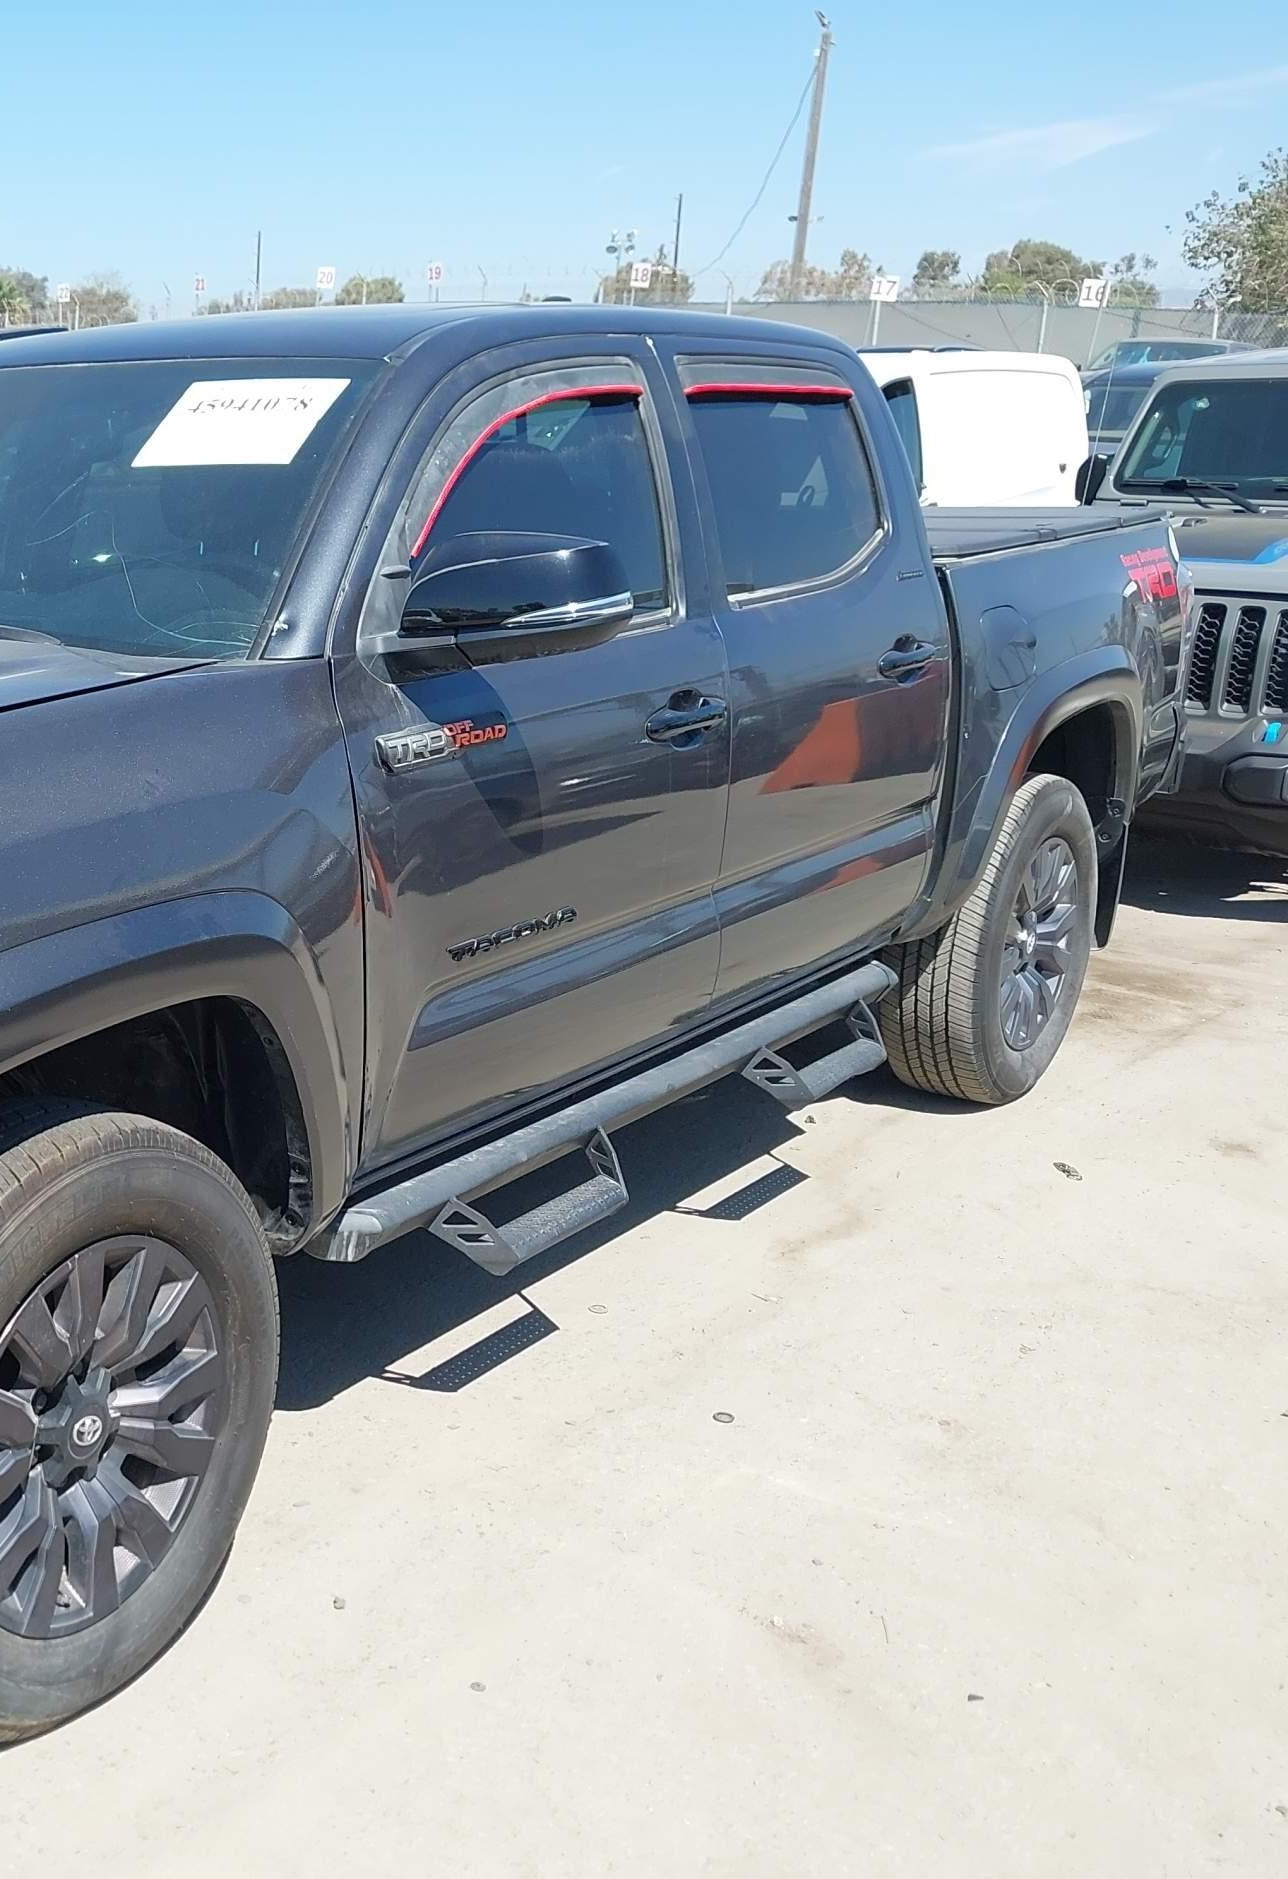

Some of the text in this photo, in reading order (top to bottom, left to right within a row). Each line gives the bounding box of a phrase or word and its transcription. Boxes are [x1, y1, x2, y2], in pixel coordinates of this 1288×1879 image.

[319, 271, 333, 284] 20
[428, 266, 441, 280] 19
[633, 267, 650, 282] 18
[195, 278, 205, 291] 21
[872, 280, 897, 296] 17
[1082, 286, 1106, 302] 16
[443, 719, 474, 737] OFF
[454, 724, 507, 748] ROAD
[385, 730, 447, 764] TRD
[446, 905, 577, 961] TACOMA
